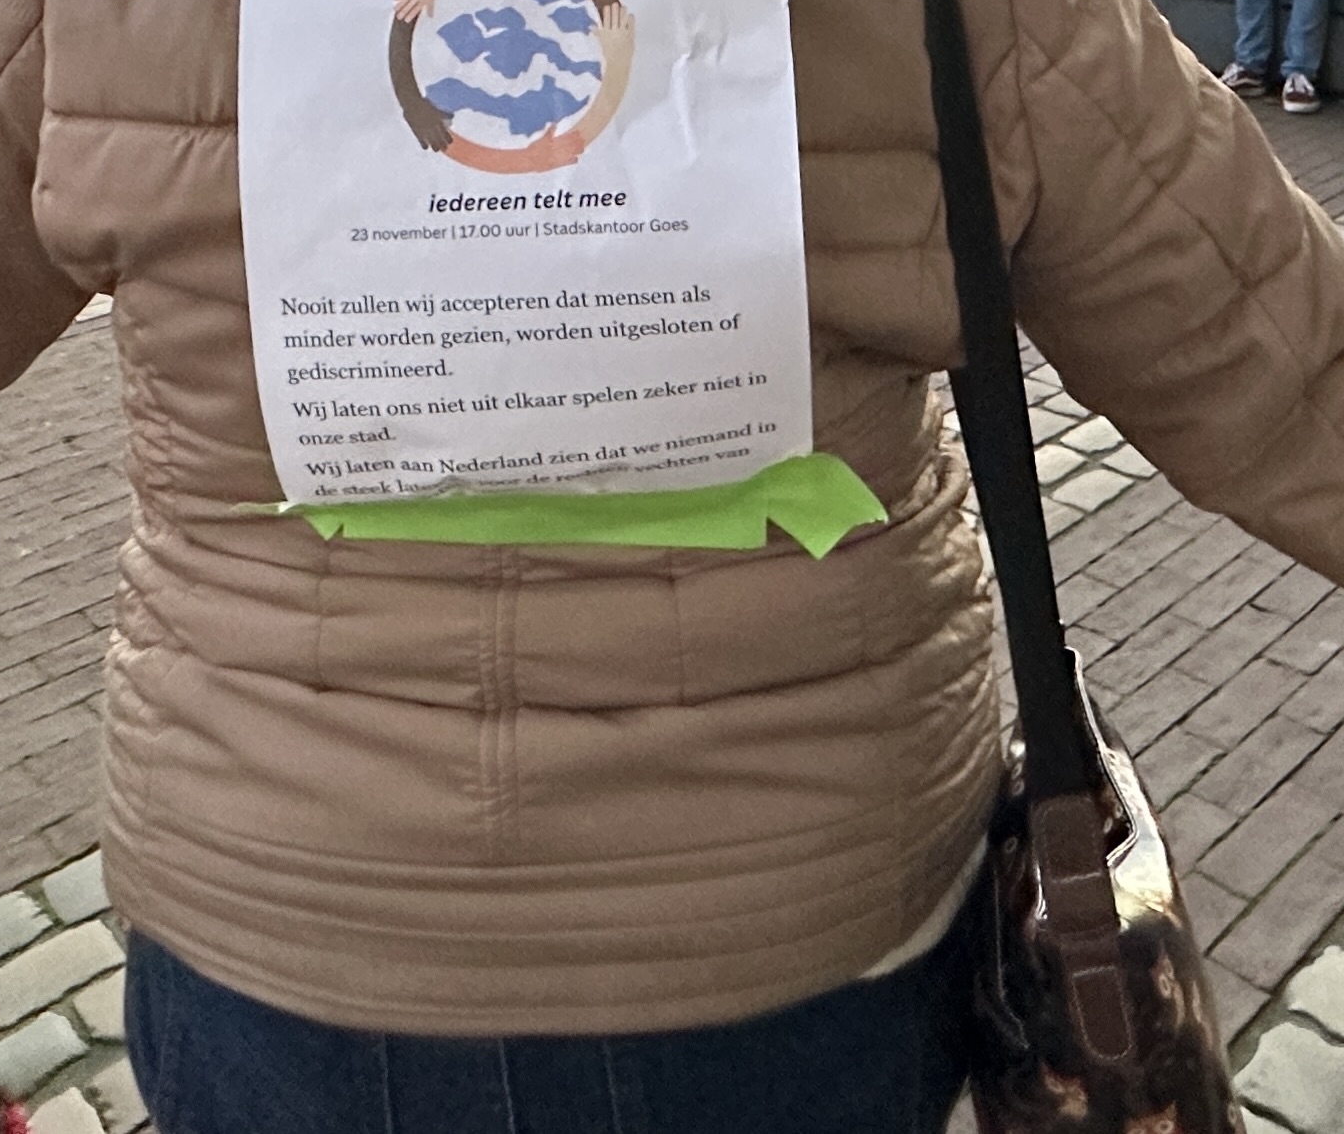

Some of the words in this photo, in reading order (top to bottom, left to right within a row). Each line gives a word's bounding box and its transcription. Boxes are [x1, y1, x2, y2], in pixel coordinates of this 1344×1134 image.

[428, 193, 526, 213] iedereen
[534, 190, 573, 209] telt
[579, 190, 627, 207] mee
[351, 228, 369, 242] 23
[372, 226, 446, 242] november
[459, 224, 501, 238] 17.00
[506, 226, 529, 237] uur
[543, 220, 645, 236] Stadskantoor
[650, 218, 689, 232] Goes
[281, 297, 335, 315] Nooit
[341, 295, 399, 314] zullen
[406, 294, 435, 316] wij
[441, 295, 550, 315] accepteren
[556, 290, 588, 308] dat
[594, 291, 675, 306] mensen
[682, 285, 711, 303] als
[284, 330, 356, 348] minder
[361, 328, 435, 346] worden
[441, 326, 510, 348] gezien,
[517, 323, 593, 341] worden
[599, 317, 713, 341] uitgesloten
[719, 313, 741, 331] of
[287, 359, 453, 385] gediscrimineerd.
[293, 400, 327, 420] Wij
[333, 398, 381, 418] laten
[387, 400, 422, 416] ons
[427, 395, 467, 414] niet
[472, 393, 499, 411] uit
[504, 390, 567, 411] elkaar
[572, 386, 637, 408] spelen
[643, 381, 698, 398] zeker
[703, 375, 742, 391] niet
[748, 372, 767, 386] in
[299, 430, 343, 445] onze
[349, 427, 396, 444] stad.
[307, 463, 342, 476] Wij
[348, 459, 395, 474] laten
[401, 460, 433, 472] aan
[440, 453, 543, 473] Nederland
[549, 452, 589, 464] zien
[595, 447, 627, 460] dat
[633, 444, 660, 454] we
[666, 424, 751, 450] niemand
[758, 422, 776, 433] in
[315, 485, 337, 496] de
[342, 481, 392, 495] steek
[526, 474, 550, 484] de
[715, 447, 750, 459] van
